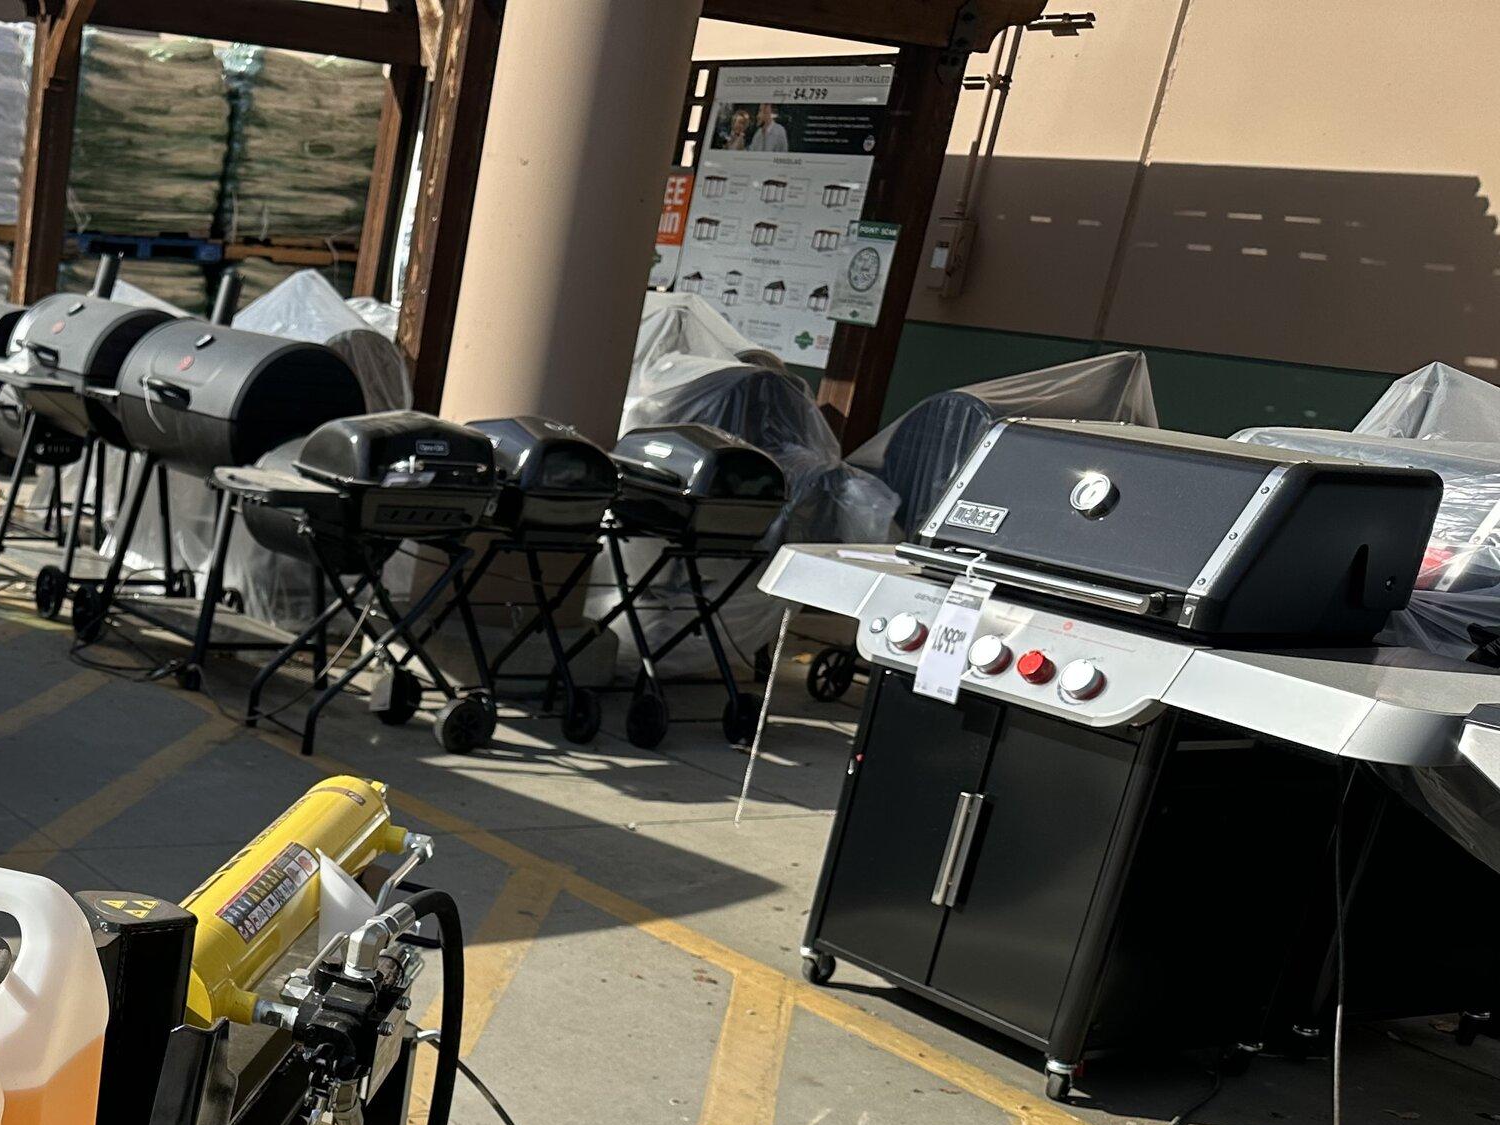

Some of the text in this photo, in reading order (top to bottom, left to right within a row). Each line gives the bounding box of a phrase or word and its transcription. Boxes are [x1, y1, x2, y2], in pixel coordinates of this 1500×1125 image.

[792, 75, 852, 84] PROFESSIONALLY
[852, 74, 891, 84] INSTALLED
[793, 87, 829, 100] $4,799
[663, 176, 688, 205] EE
